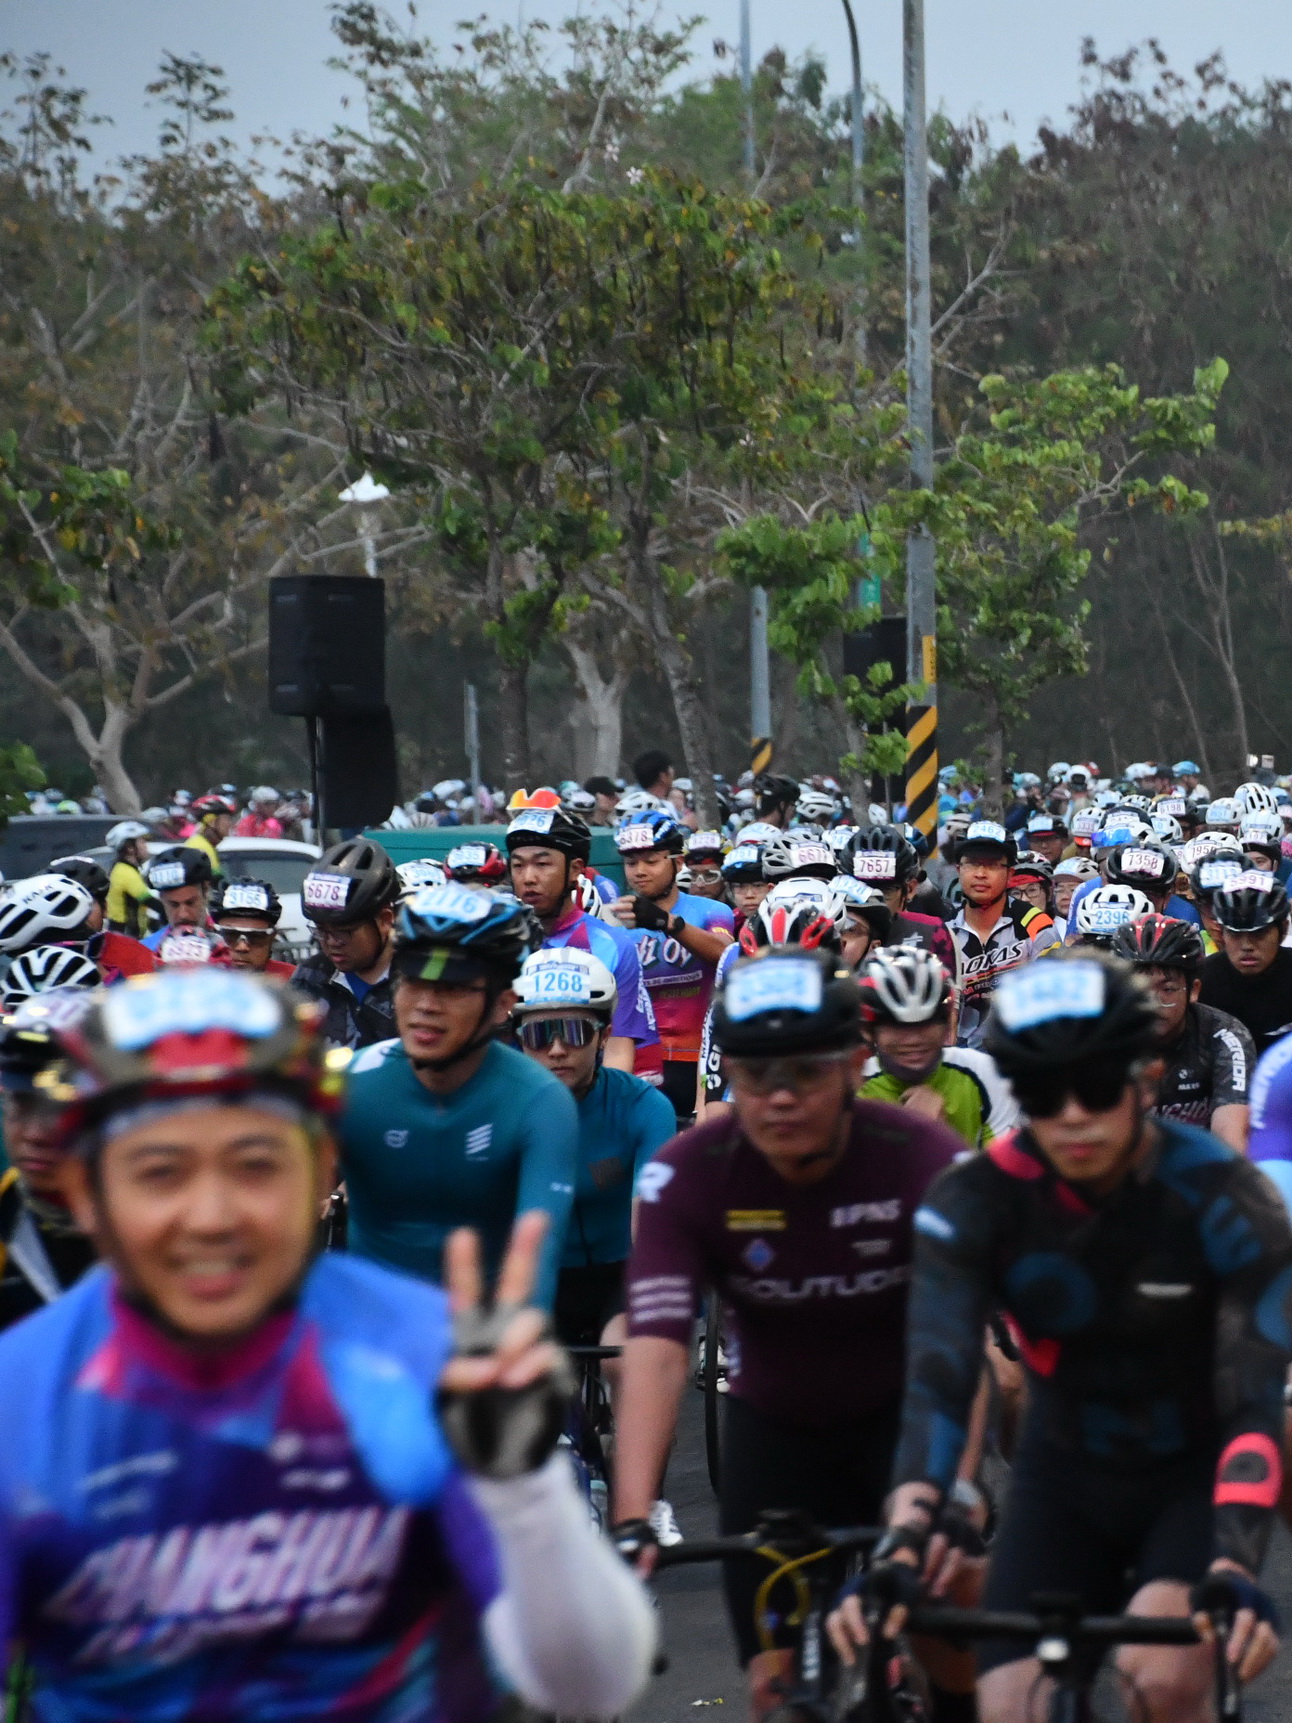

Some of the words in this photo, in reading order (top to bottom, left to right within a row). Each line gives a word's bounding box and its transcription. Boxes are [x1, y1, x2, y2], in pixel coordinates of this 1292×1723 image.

[859, 858, 890, 873] 7657
[1127, 853, 1158, 870] 7358
[307, 881, 340, 900] 6678
[1095, 910, 1131, 925] 2396
[534, 972, 583, 993] 1268
[1212, 1028, 1246, 1092] MERIDA
